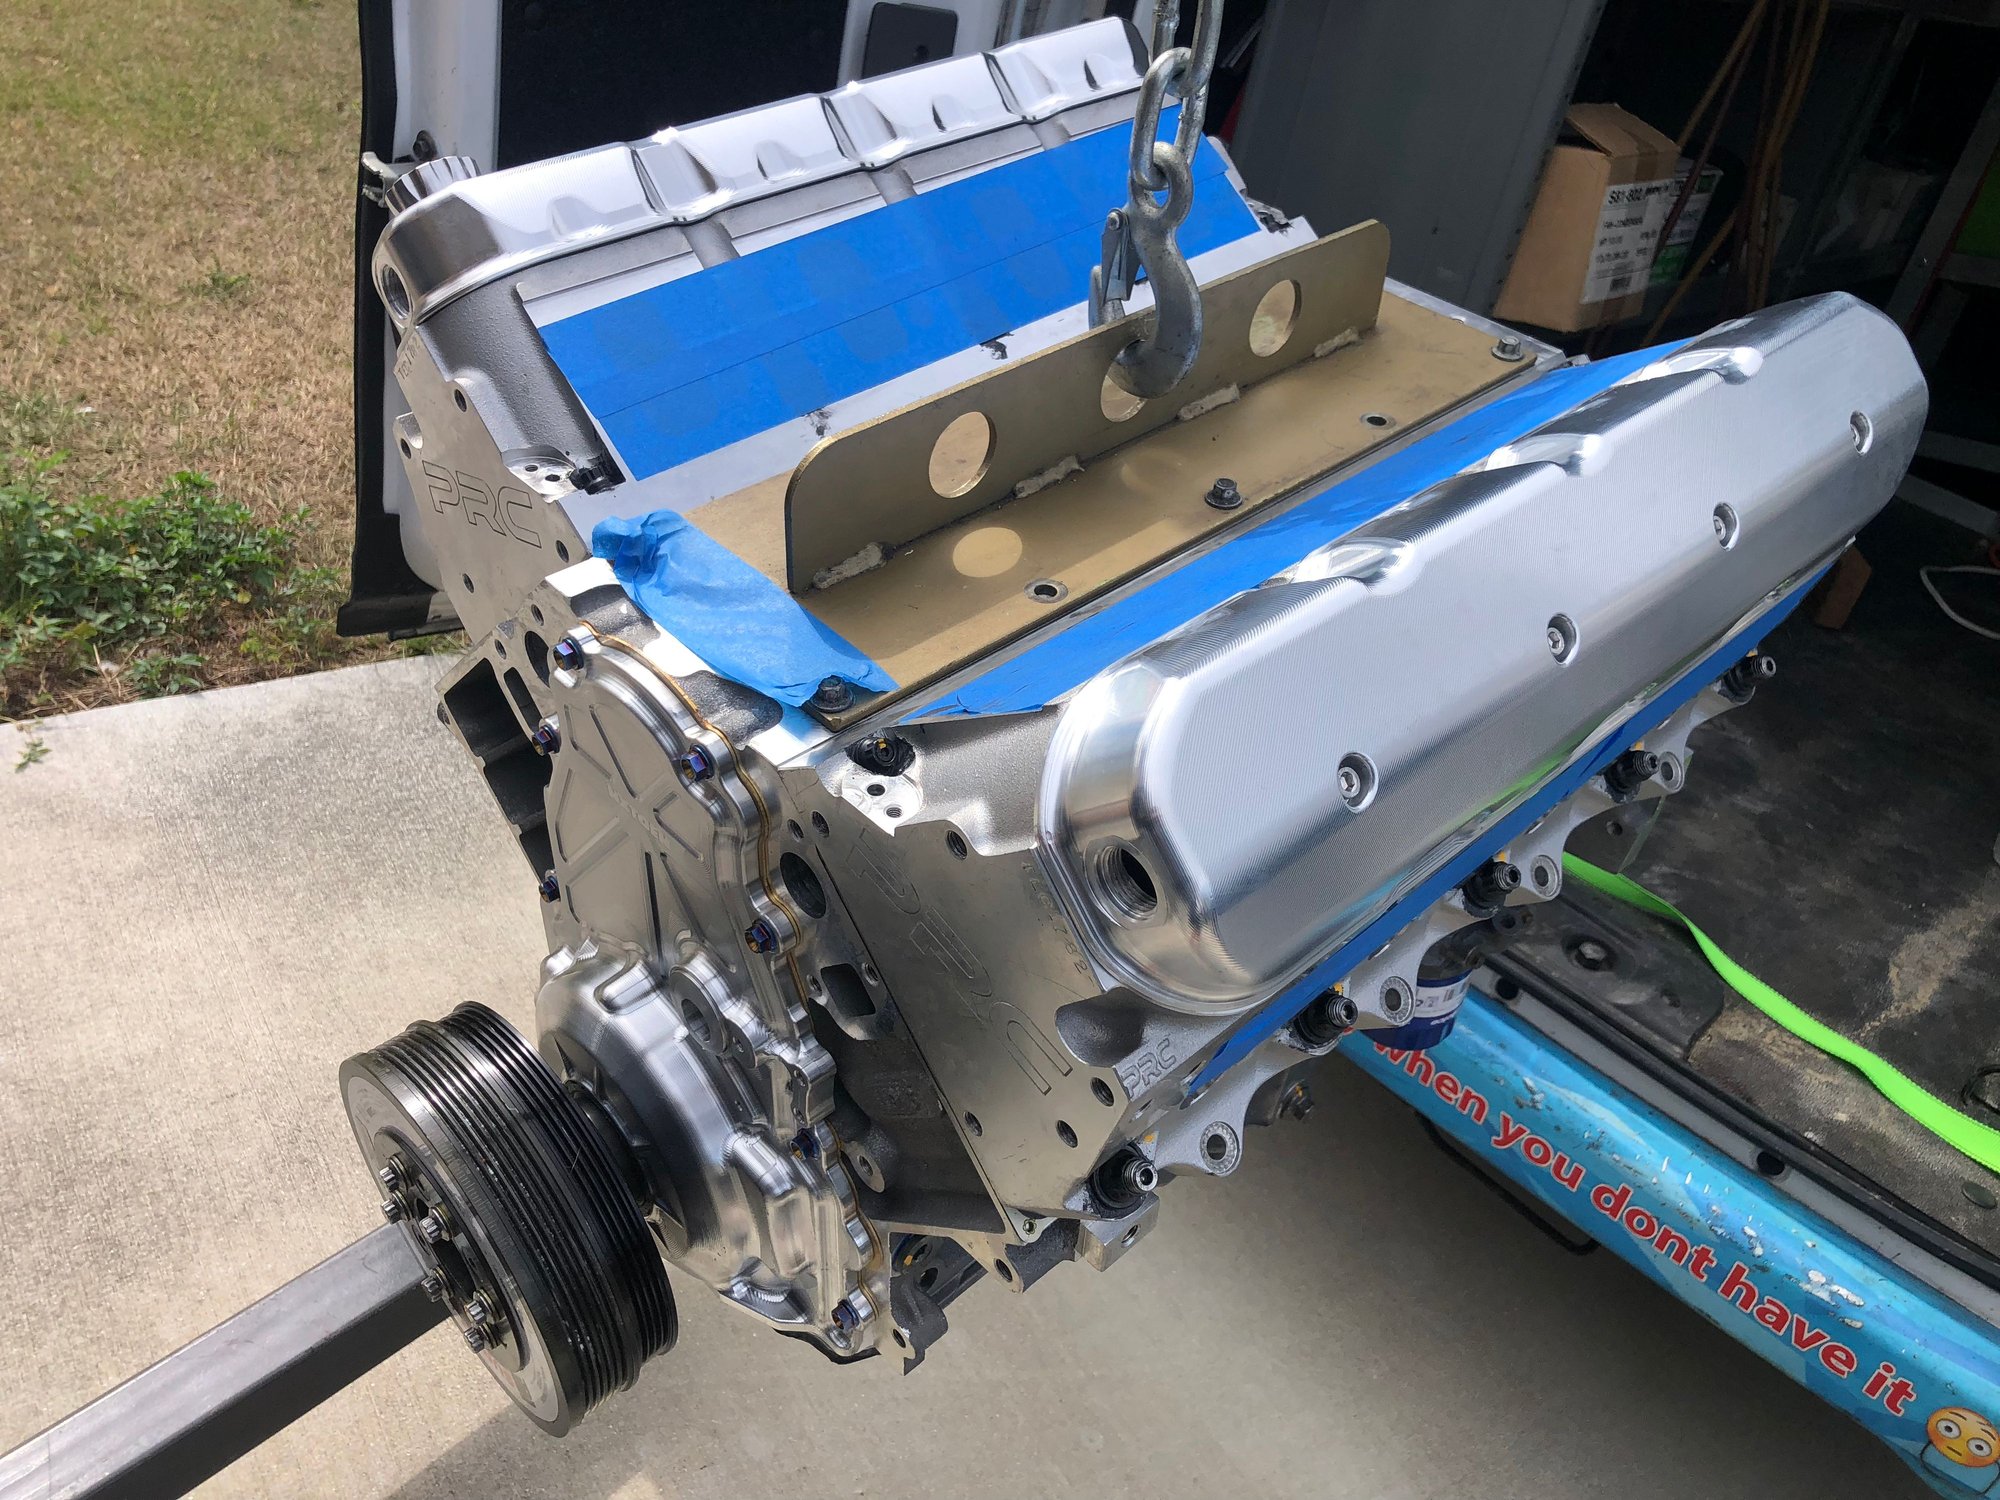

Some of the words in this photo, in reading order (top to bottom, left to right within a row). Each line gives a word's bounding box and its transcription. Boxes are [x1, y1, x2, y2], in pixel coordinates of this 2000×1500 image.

[422, 459, 542, 549] PRC
[1120, 1038, 1177, 1098] PRC
[1491, 1113, 1585, 1191] you
[1591, 1184, 1716, 1282] dont
[1718, 1262, 1857, 1378] have
[1863, 1363, 1916, 1416] it
